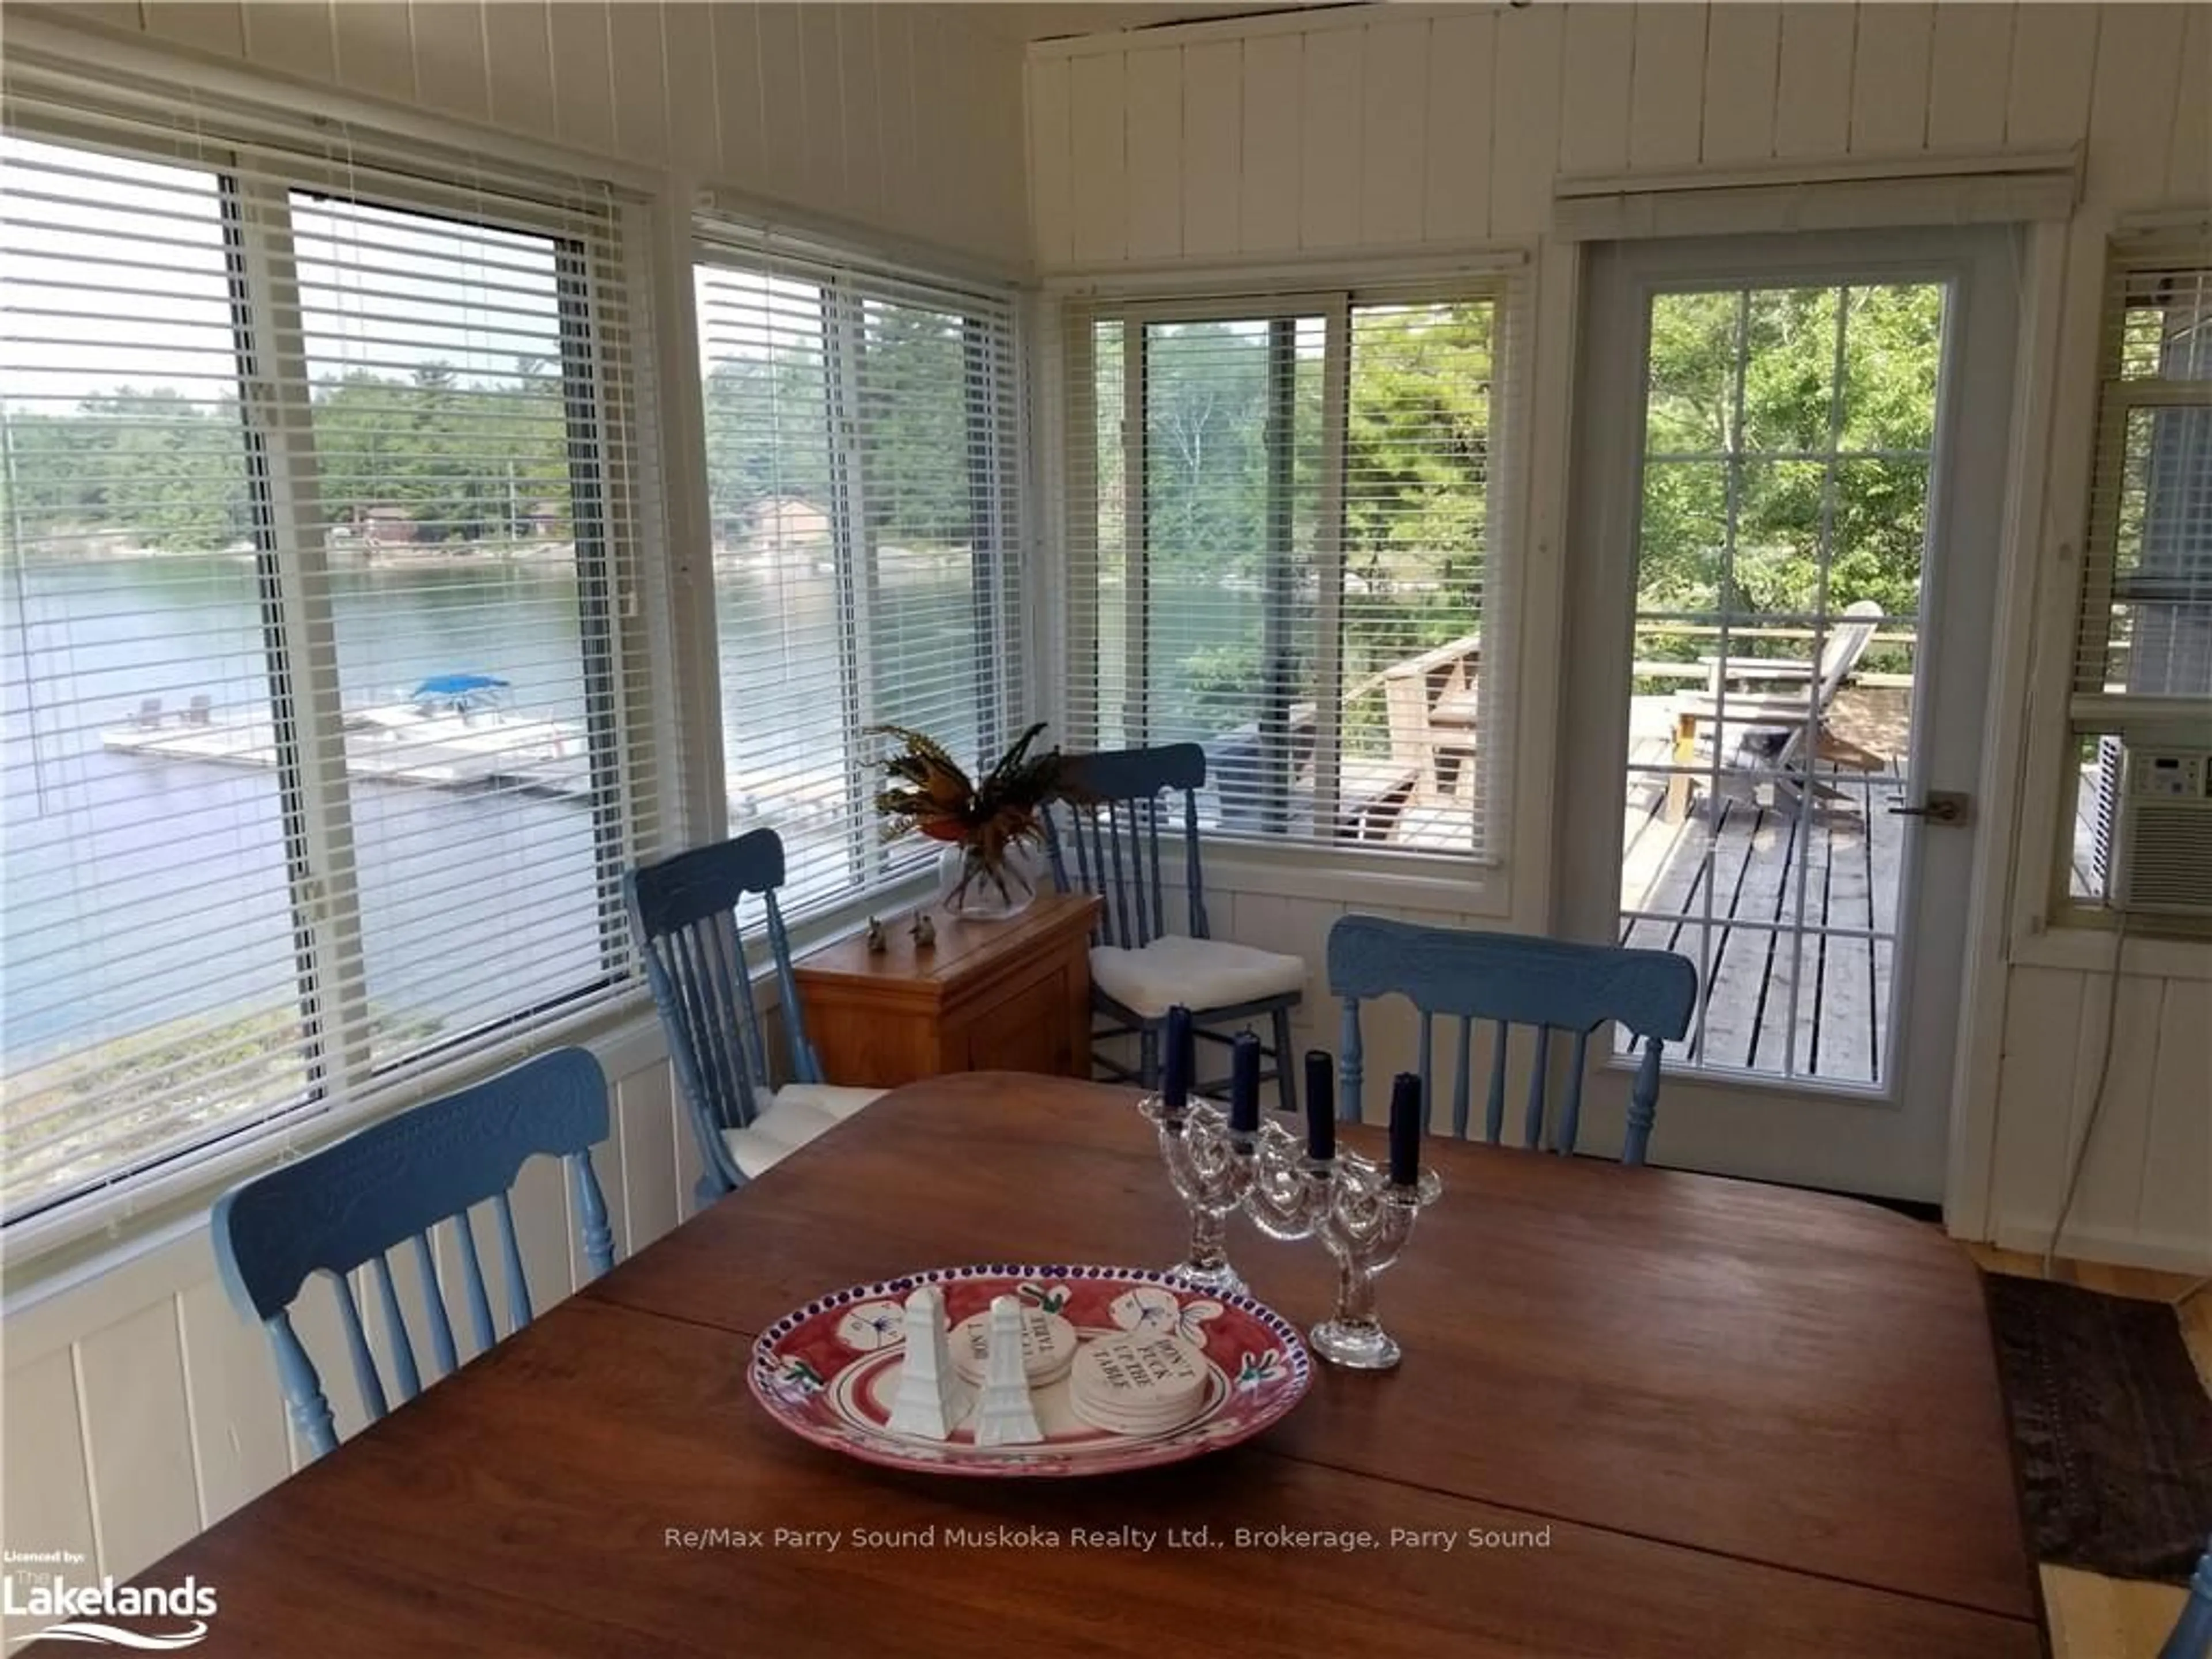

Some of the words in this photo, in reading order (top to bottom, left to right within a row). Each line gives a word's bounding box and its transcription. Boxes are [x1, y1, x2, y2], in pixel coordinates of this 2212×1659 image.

[1093, 1351, 1131, 1388] TABLE
[1113, 1344, 1134, 1361] UP
[1125, 1363, 1155, 1387] THE
[1136, 1345, 1173, 1379] FUCK
[1154, 1339, 1195, 1377] DON'T
